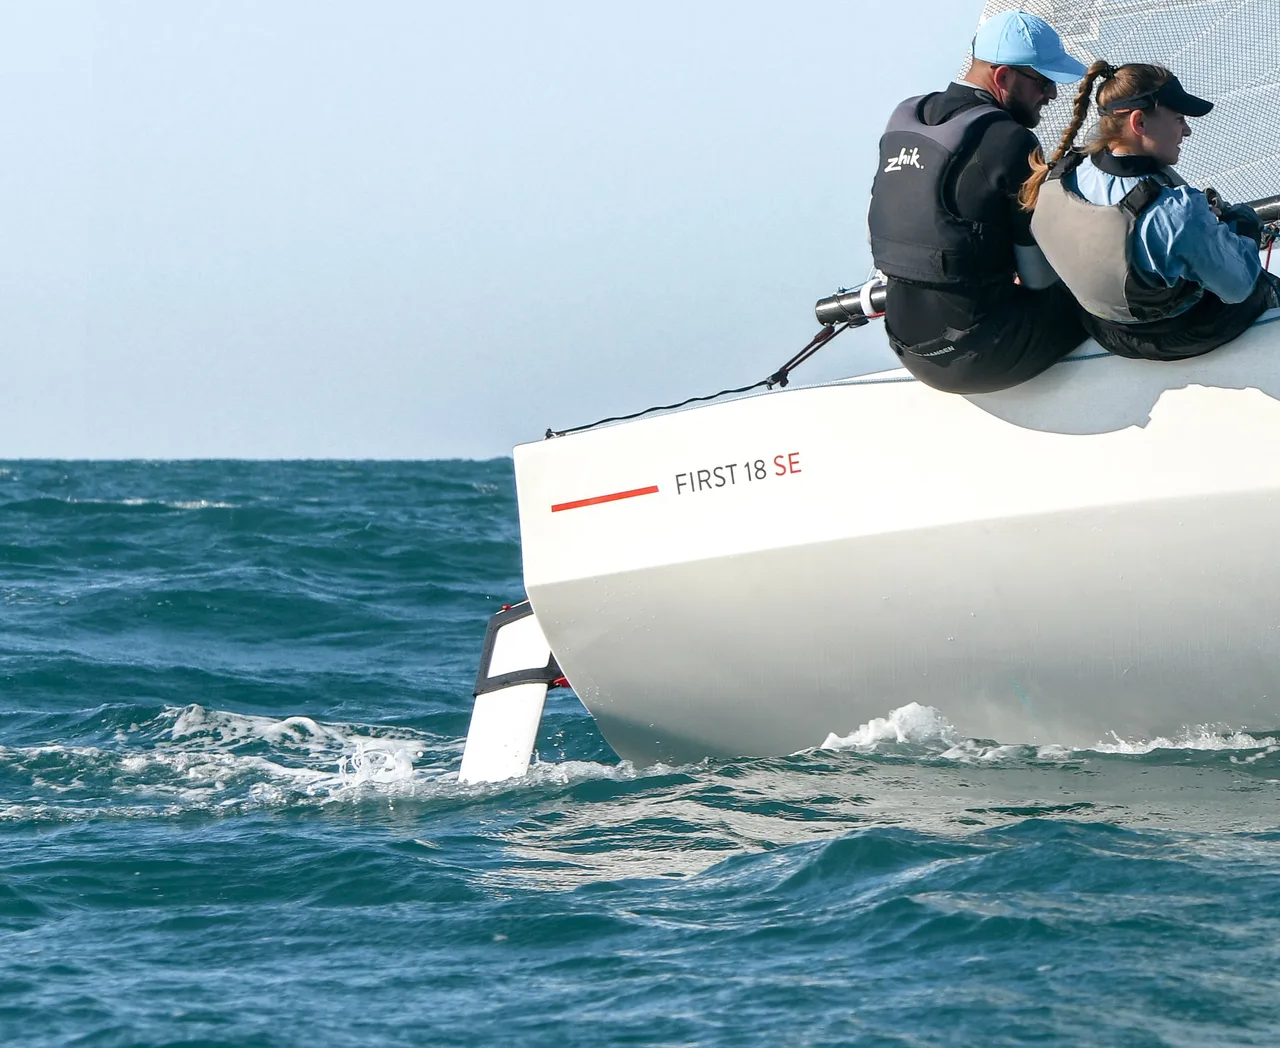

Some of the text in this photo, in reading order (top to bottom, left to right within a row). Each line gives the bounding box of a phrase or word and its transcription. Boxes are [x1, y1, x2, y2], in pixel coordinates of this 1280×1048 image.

[675, 451, 802, 495] FIRST 18 SE
